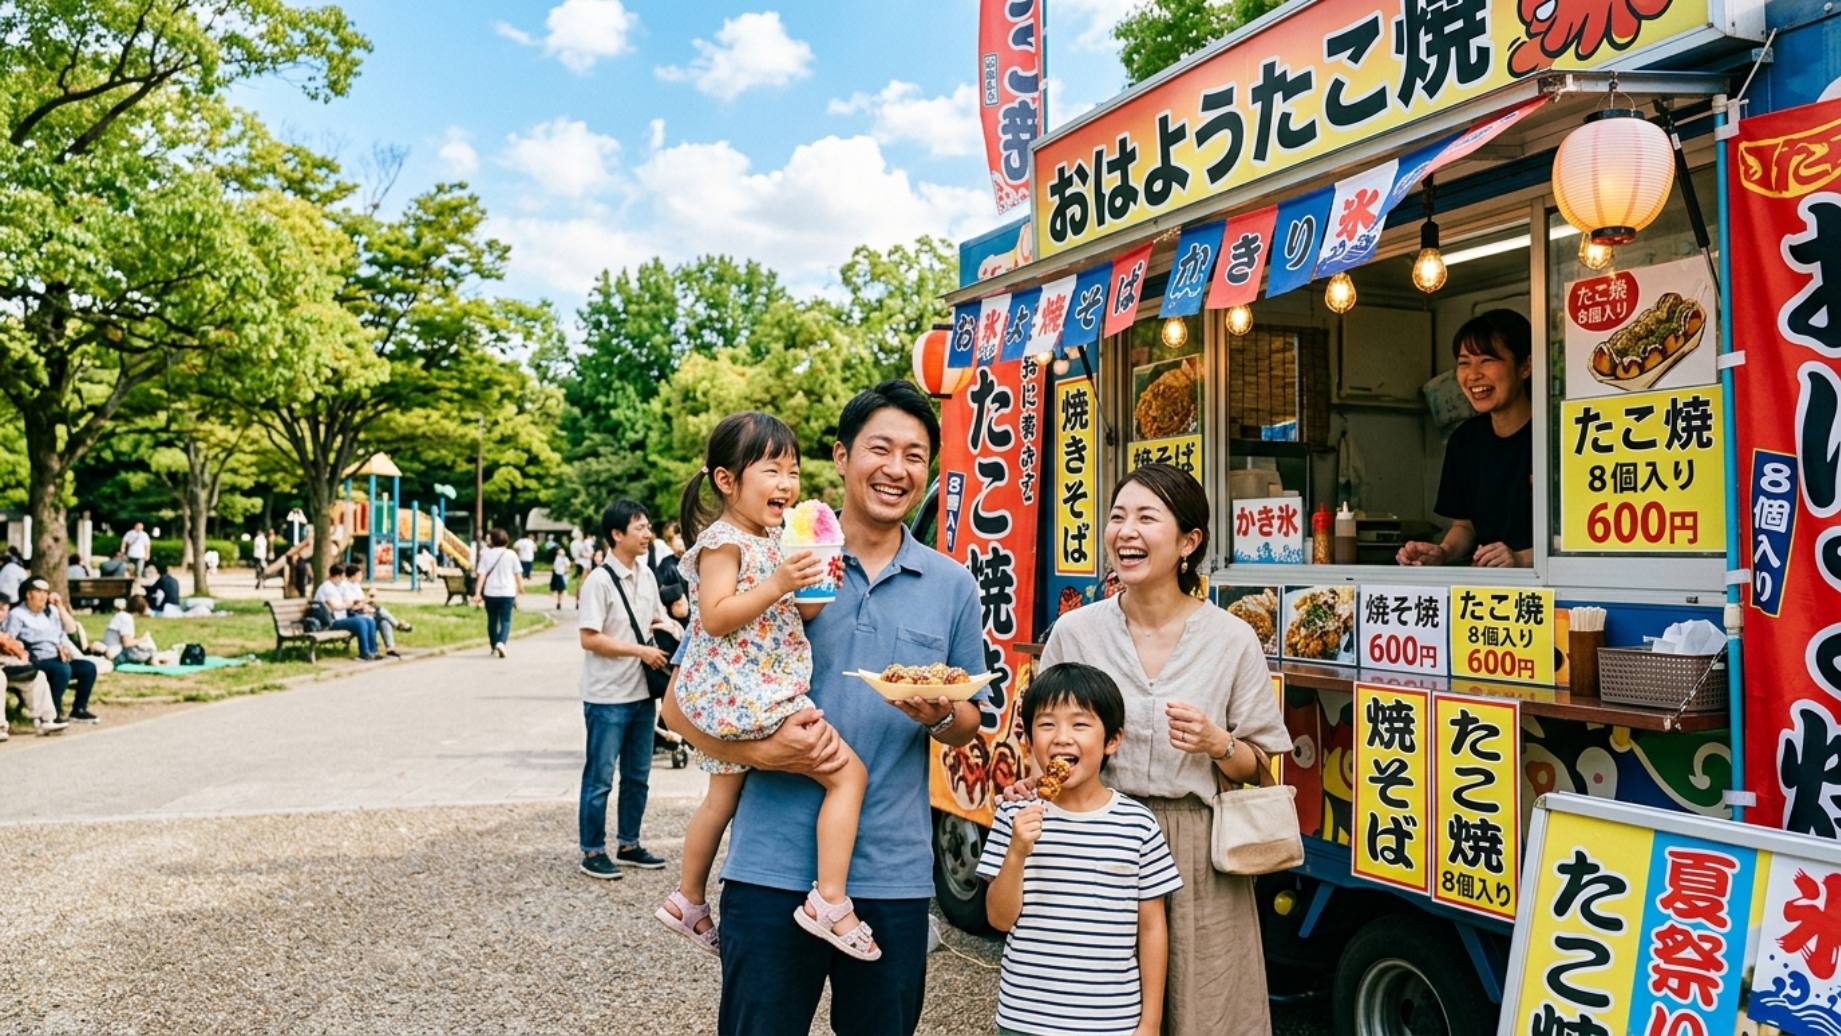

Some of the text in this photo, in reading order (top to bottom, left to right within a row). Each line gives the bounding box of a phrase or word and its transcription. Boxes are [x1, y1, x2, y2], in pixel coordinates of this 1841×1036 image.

[1050, 0, 1491, 243] おはようたこ焼
[1574, 396, 1713, 455] たこ焼
[1061, 389, 1089, 564] 焼きそば
[1588, 460, 1694, 493] 8個入り
[1236, 504, 1299, 538] かき氷
[1587, 501, 1698, 544] 600円
[1754, 463, 1791, 601] 8個入り
[1460, 590, 1544, 626] たこ焼
[1369, 633, 1438, 669] 600円
[1468, 626, 1533, 648] 8個入り
[1467, 649, 1535, 679] 600円
[1366, 697, 1418, 870] 焼そば
[1448, 709, 1504, 874] たこ焼
[1441, 870, 1511, 907] 8個入り
